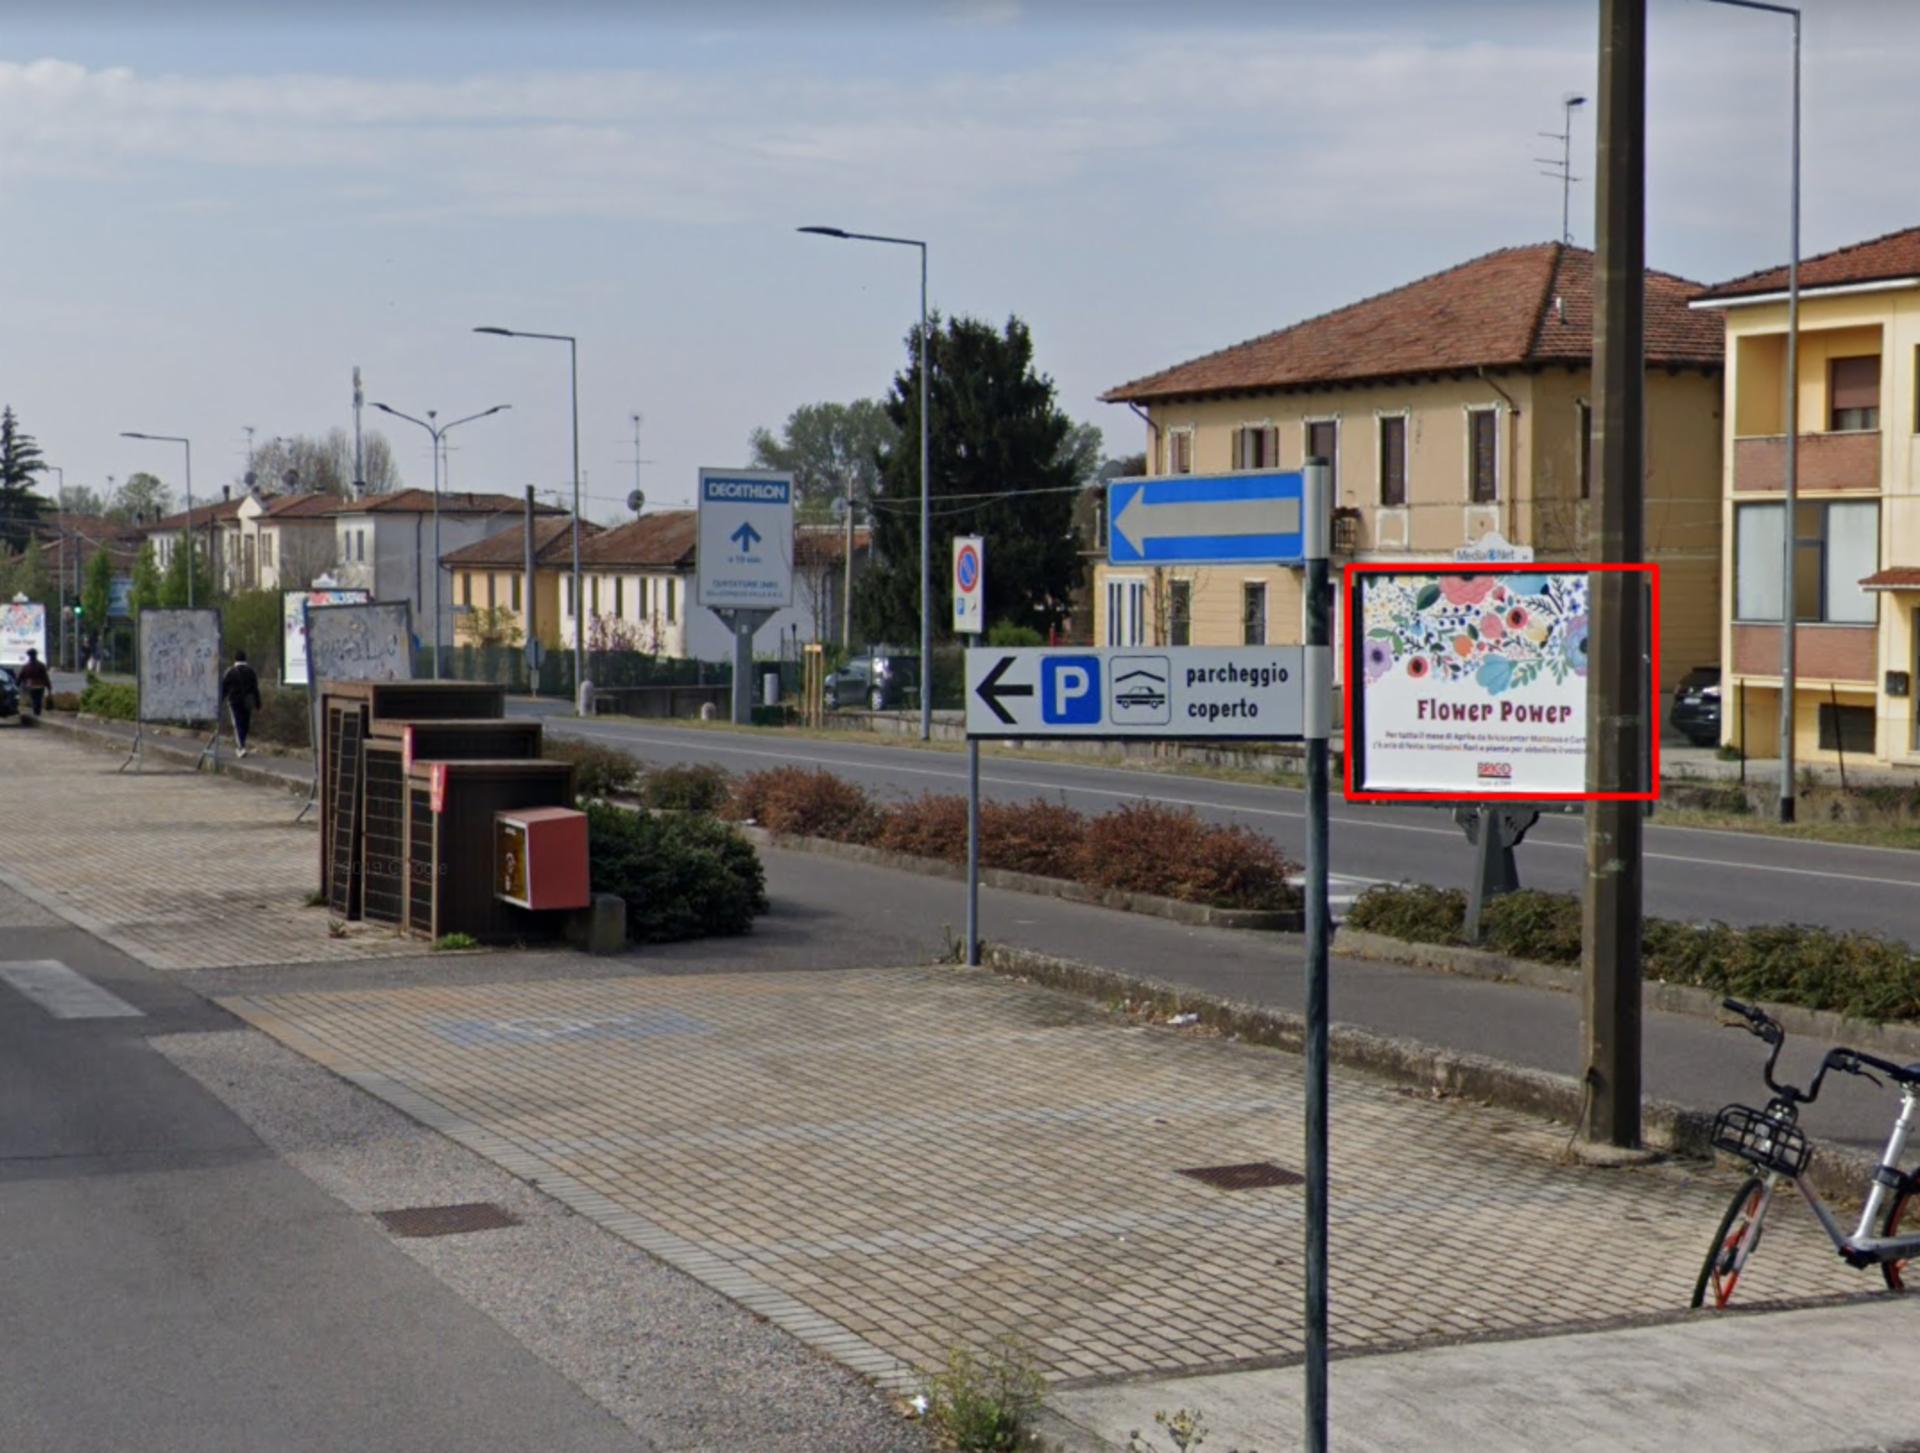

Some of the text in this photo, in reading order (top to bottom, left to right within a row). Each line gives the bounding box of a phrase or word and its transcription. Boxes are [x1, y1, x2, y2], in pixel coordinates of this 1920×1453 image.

[708, 483, 785, 499] DECATHLON
[1187, 663, 1289, 688] parcheggio
[1056, 666, 1090, 715] P
[1188, 700, 1259, 721] coperto
[1417, 698, 1573, 723] Flower Power
[1478, 762, 1511, 775] BRICO
